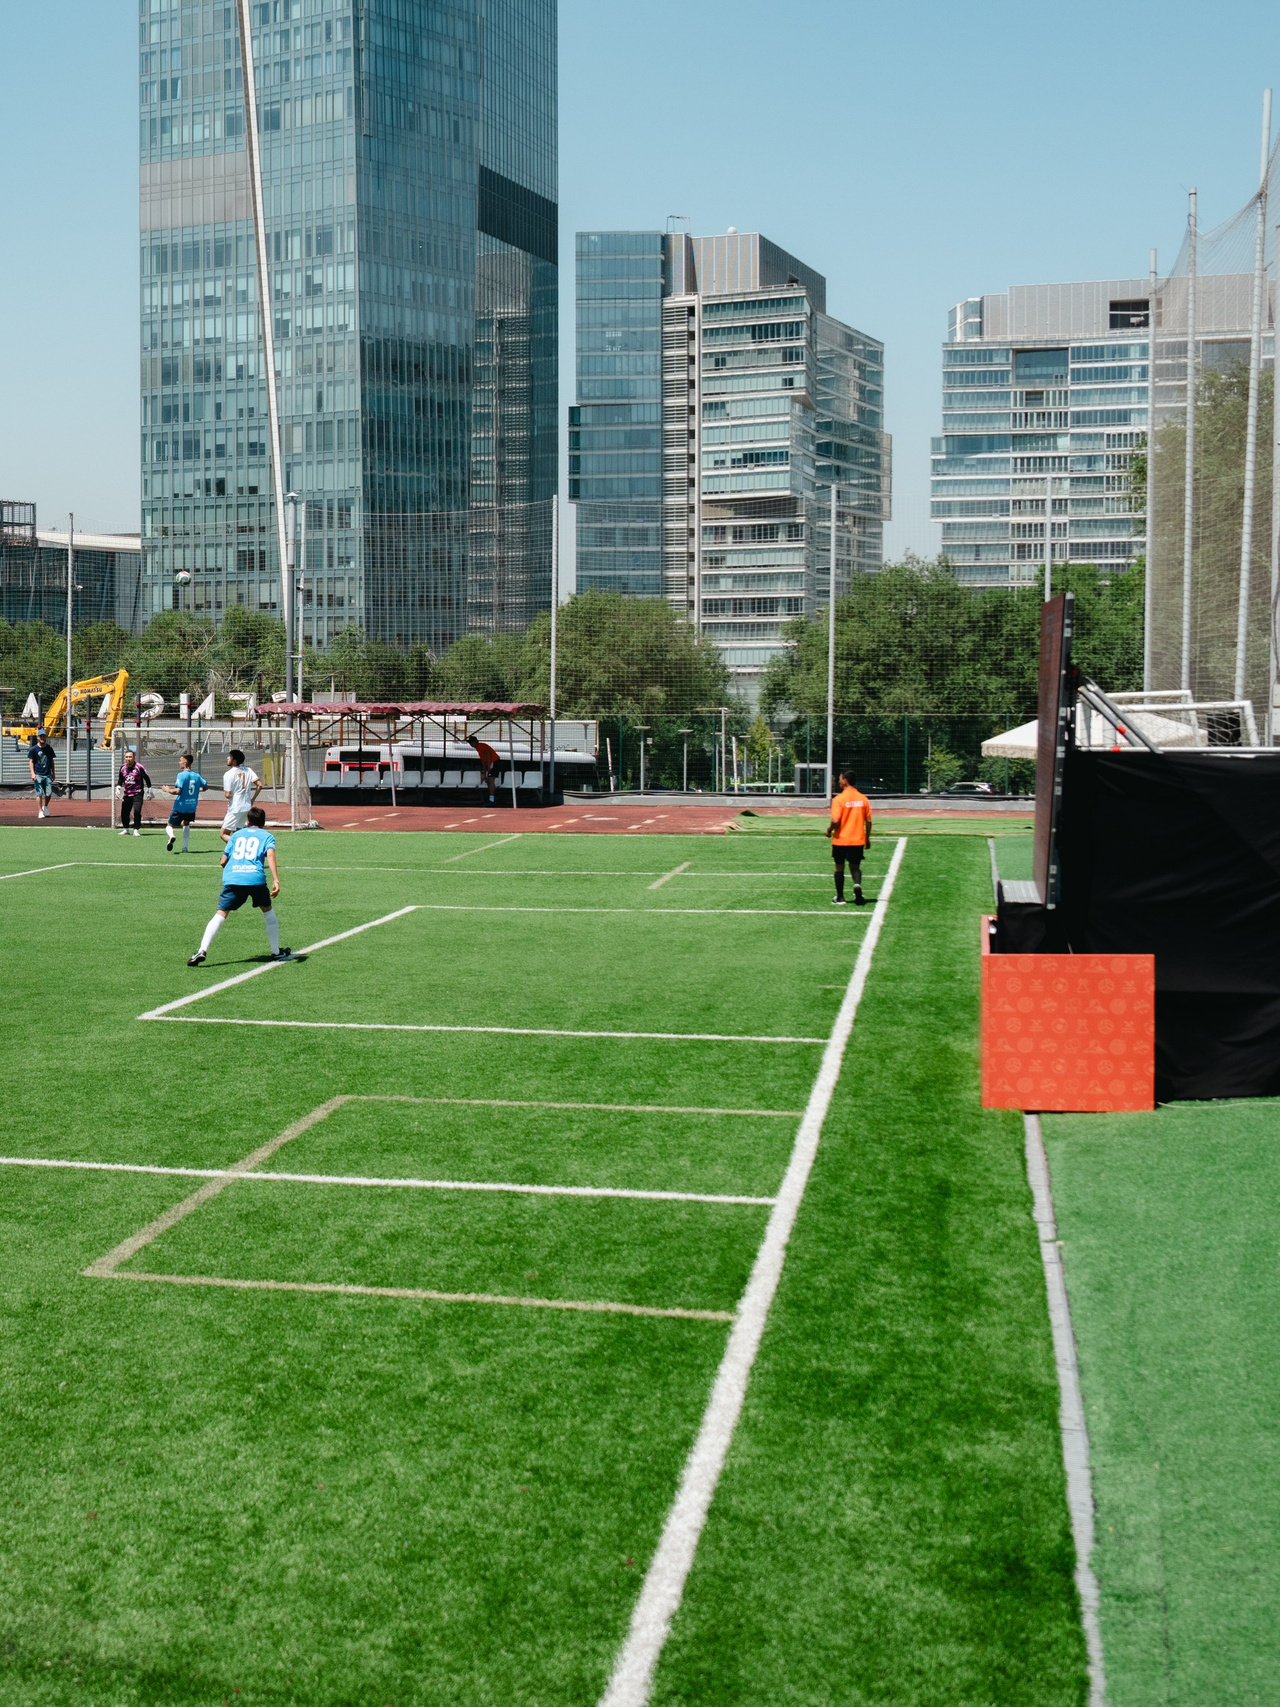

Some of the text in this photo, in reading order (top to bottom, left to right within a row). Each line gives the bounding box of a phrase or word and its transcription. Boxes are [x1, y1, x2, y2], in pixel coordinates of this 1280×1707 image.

[188, 779, 196, 796] 5
[238, 772, 246, 789] 7
[232, 836, 260, 860] 99
